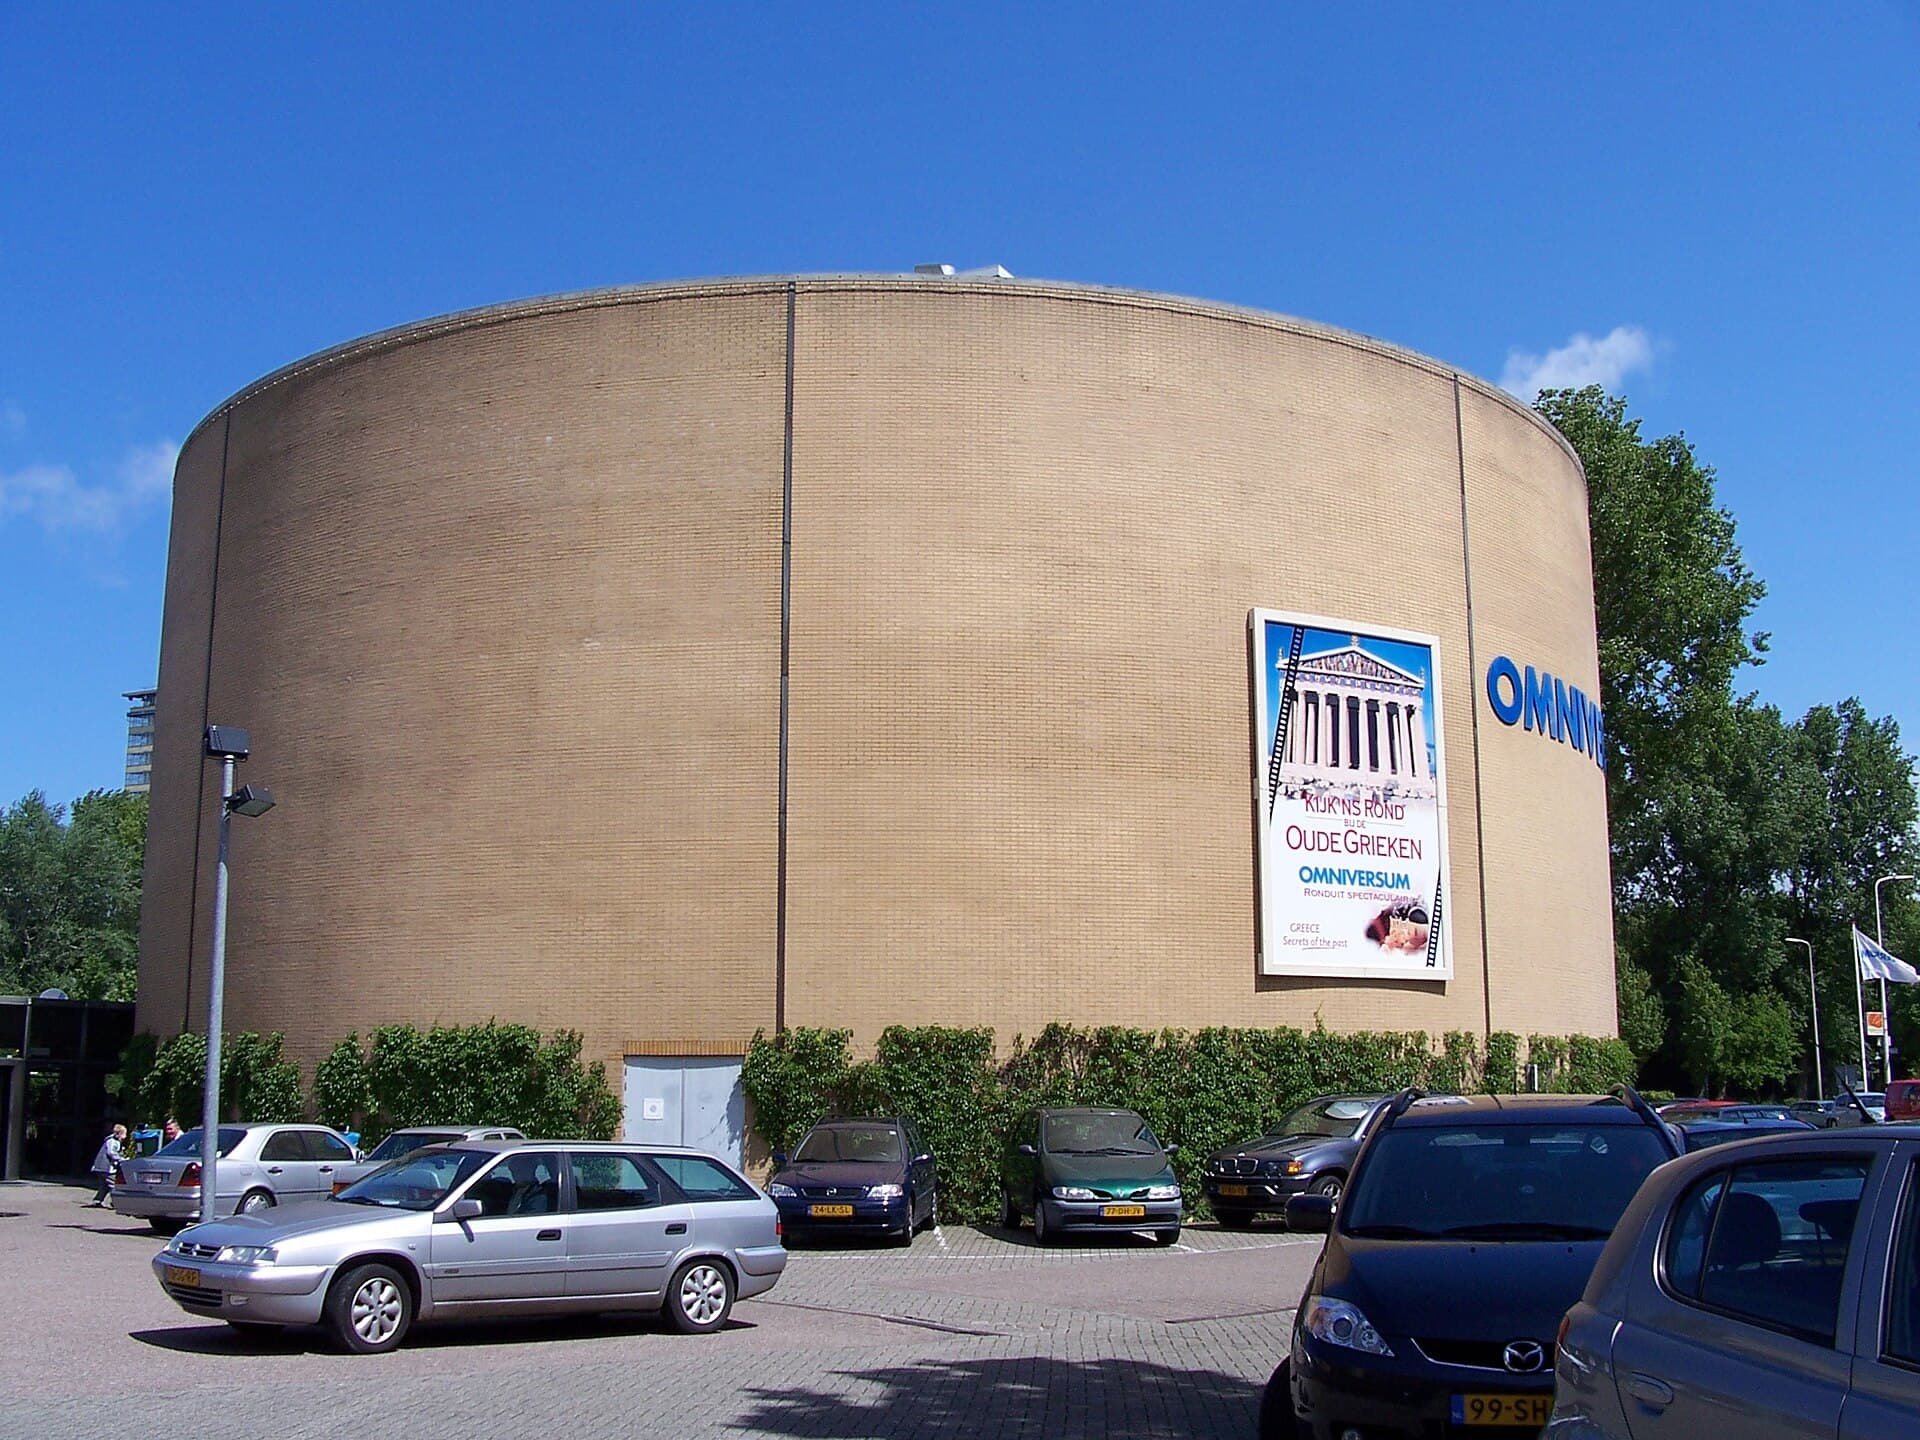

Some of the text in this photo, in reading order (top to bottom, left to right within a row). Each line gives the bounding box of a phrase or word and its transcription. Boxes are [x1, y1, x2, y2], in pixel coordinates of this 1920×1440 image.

[1364, 799, 1405, 820] ROND
[1356, 820, 1367, 829] DE
[1286, 825, 1422, 860] OUDE GRIEKEN
[1298, 865, 1411, 890] OMNIVERSUM
[1303, 887, 1345, 899] RONDUIT
[1289, 922, 1321, 934] GREECE
[1282, 935, 1309, 947] Secrets
